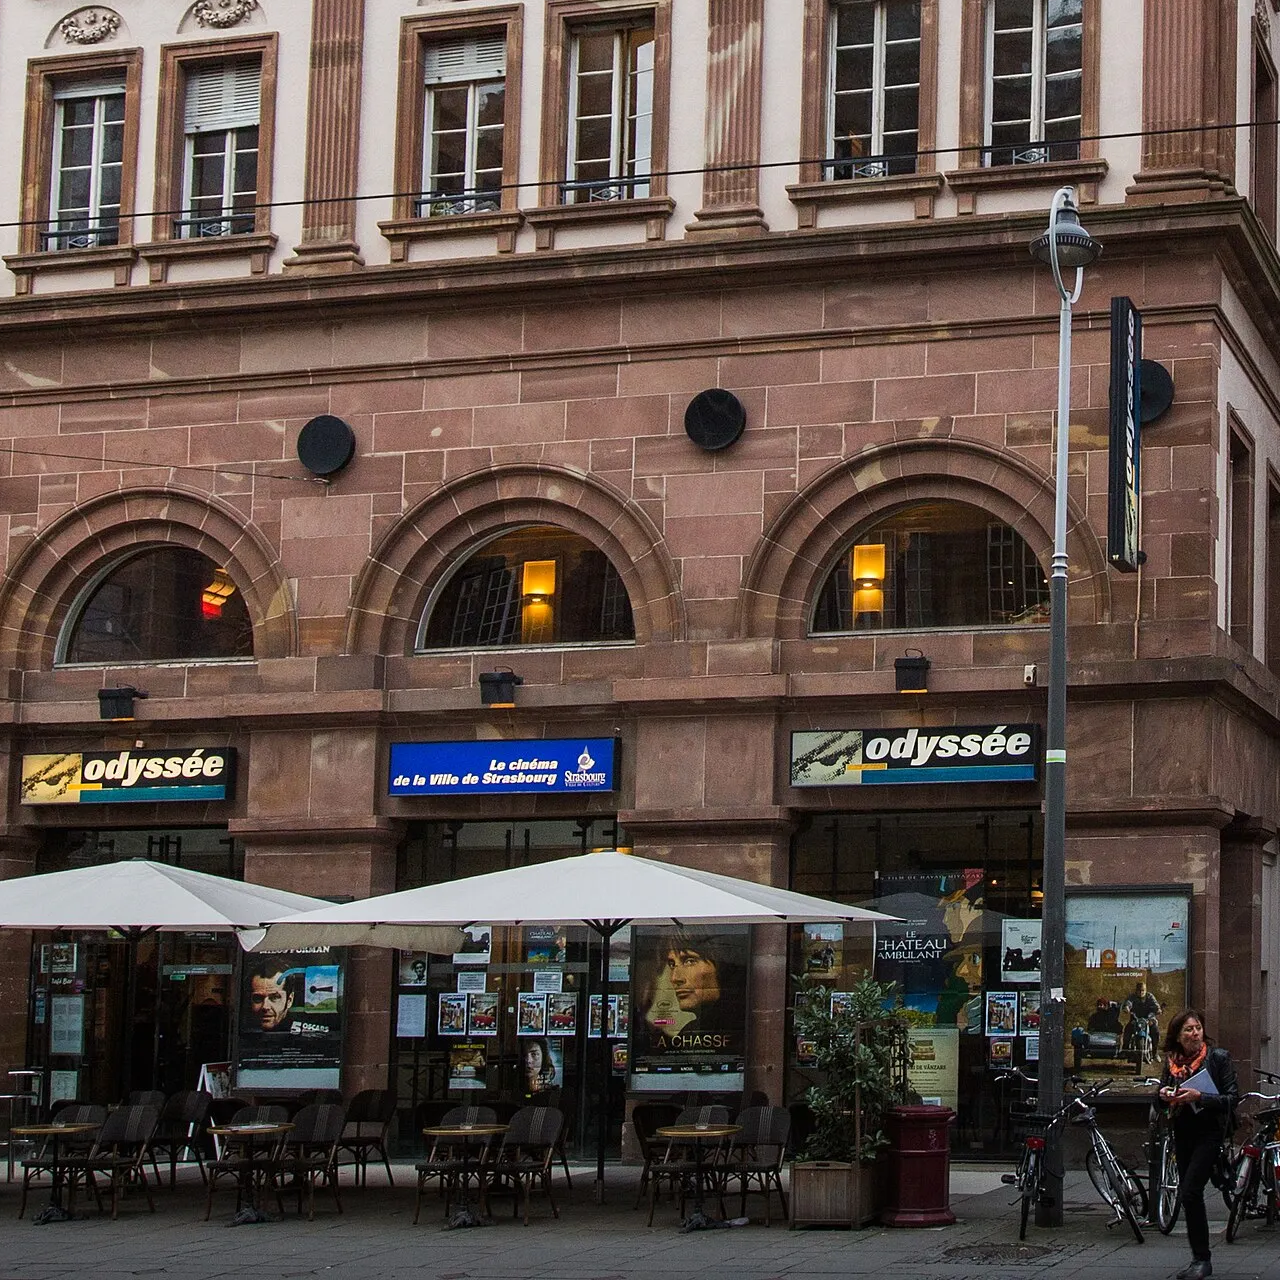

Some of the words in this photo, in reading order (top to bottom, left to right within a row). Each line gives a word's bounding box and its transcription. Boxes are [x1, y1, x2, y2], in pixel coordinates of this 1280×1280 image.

[865, 725, 1031, 766] odyssée
[83, 749, 224, 787] odyssée
[489, 759, 506, 771] Le
[509, 758, 558, 770] cinéma
[393, 775, 410, 786] de
[412, 774, 425, 785] la
[429, 774, 459, 785] Ville
[462, 772, 479, 784] de
[482, 771, 558, 786] Strasbourg
[564, 770, 606, 785] Strasbourg
[906, 930, 917, 939] LE
[877, 950, 942, 960] AMBULANT
[290, 1021, 302, 1035] 5
